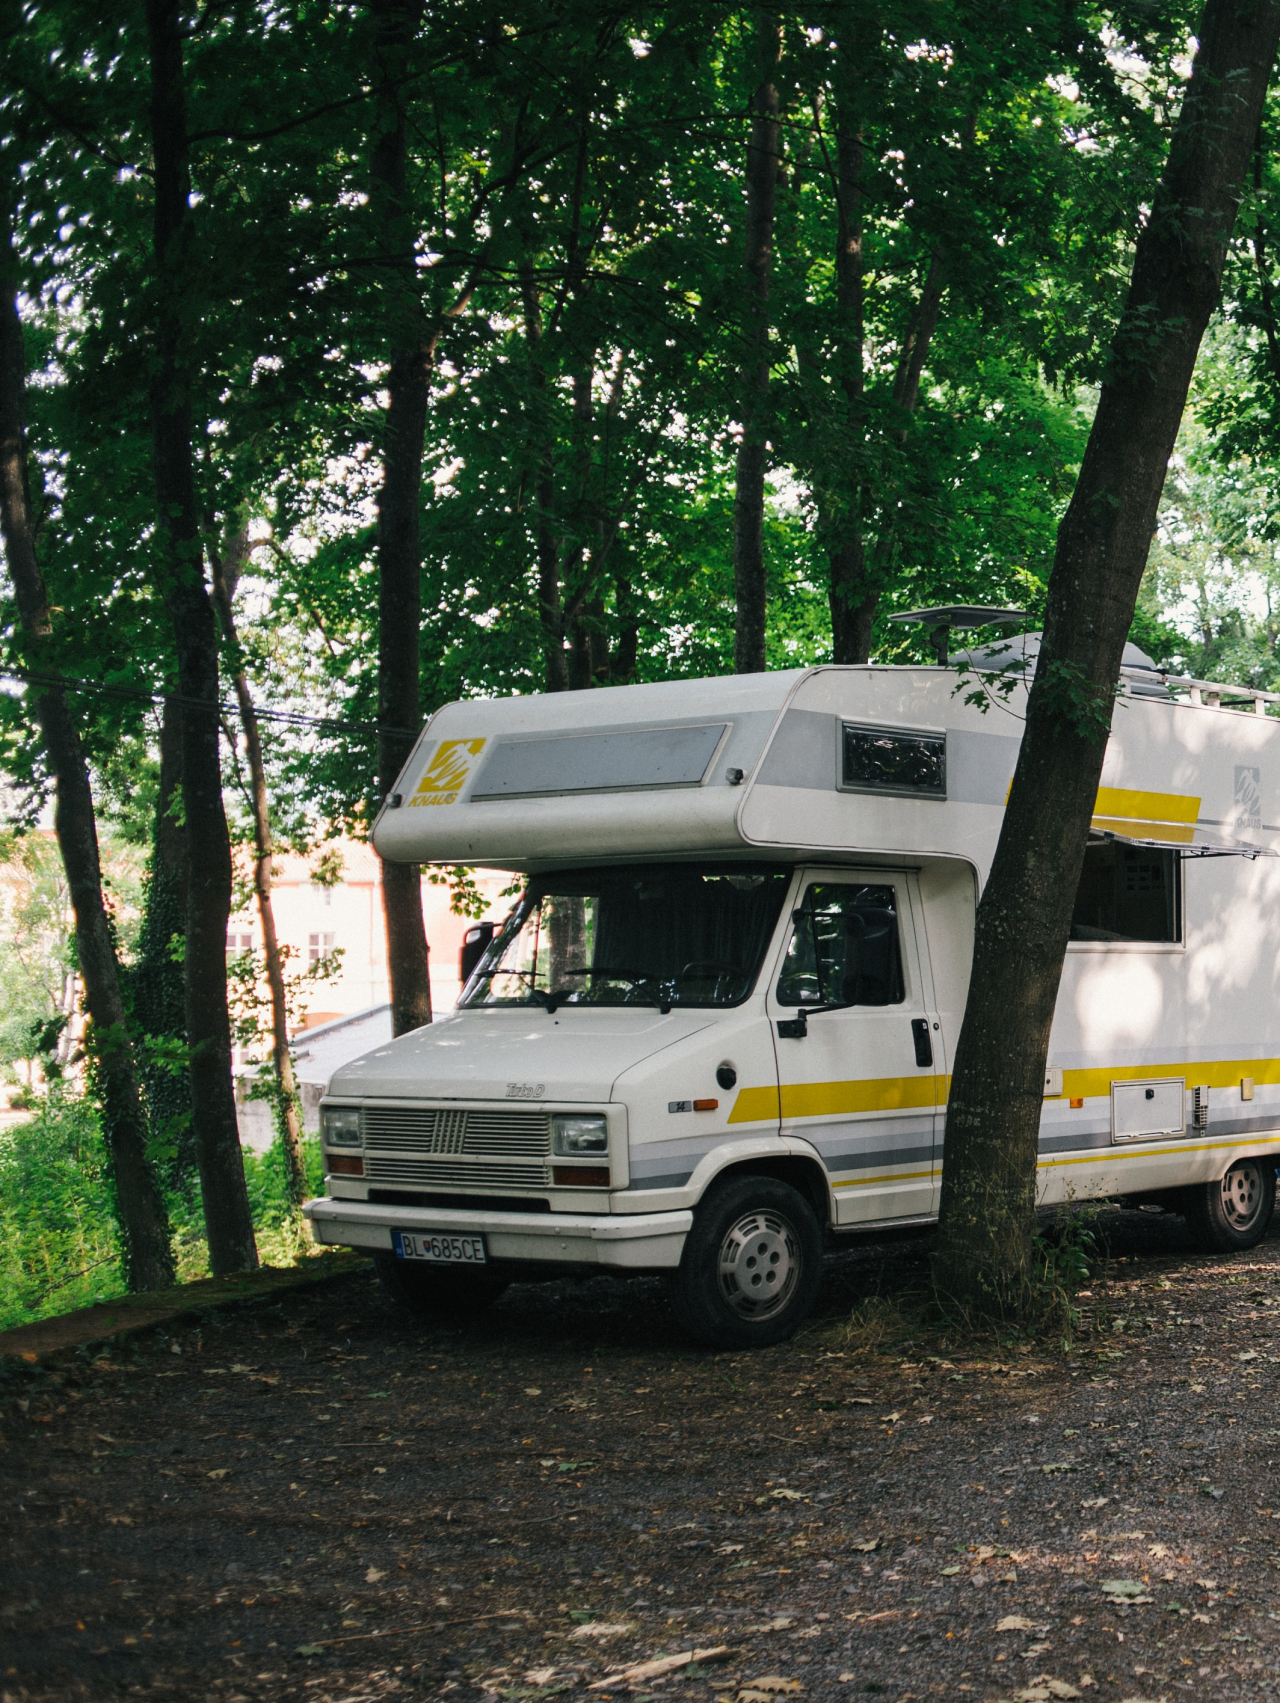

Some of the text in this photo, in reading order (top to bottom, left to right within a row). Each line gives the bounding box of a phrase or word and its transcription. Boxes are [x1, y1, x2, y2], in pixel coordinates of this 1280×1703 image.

[407, 792, 459, 807] KNAUS
[506, 1082, 533, 1098] Turbo
[402, 1235, 484, 1260] BL 685CE
